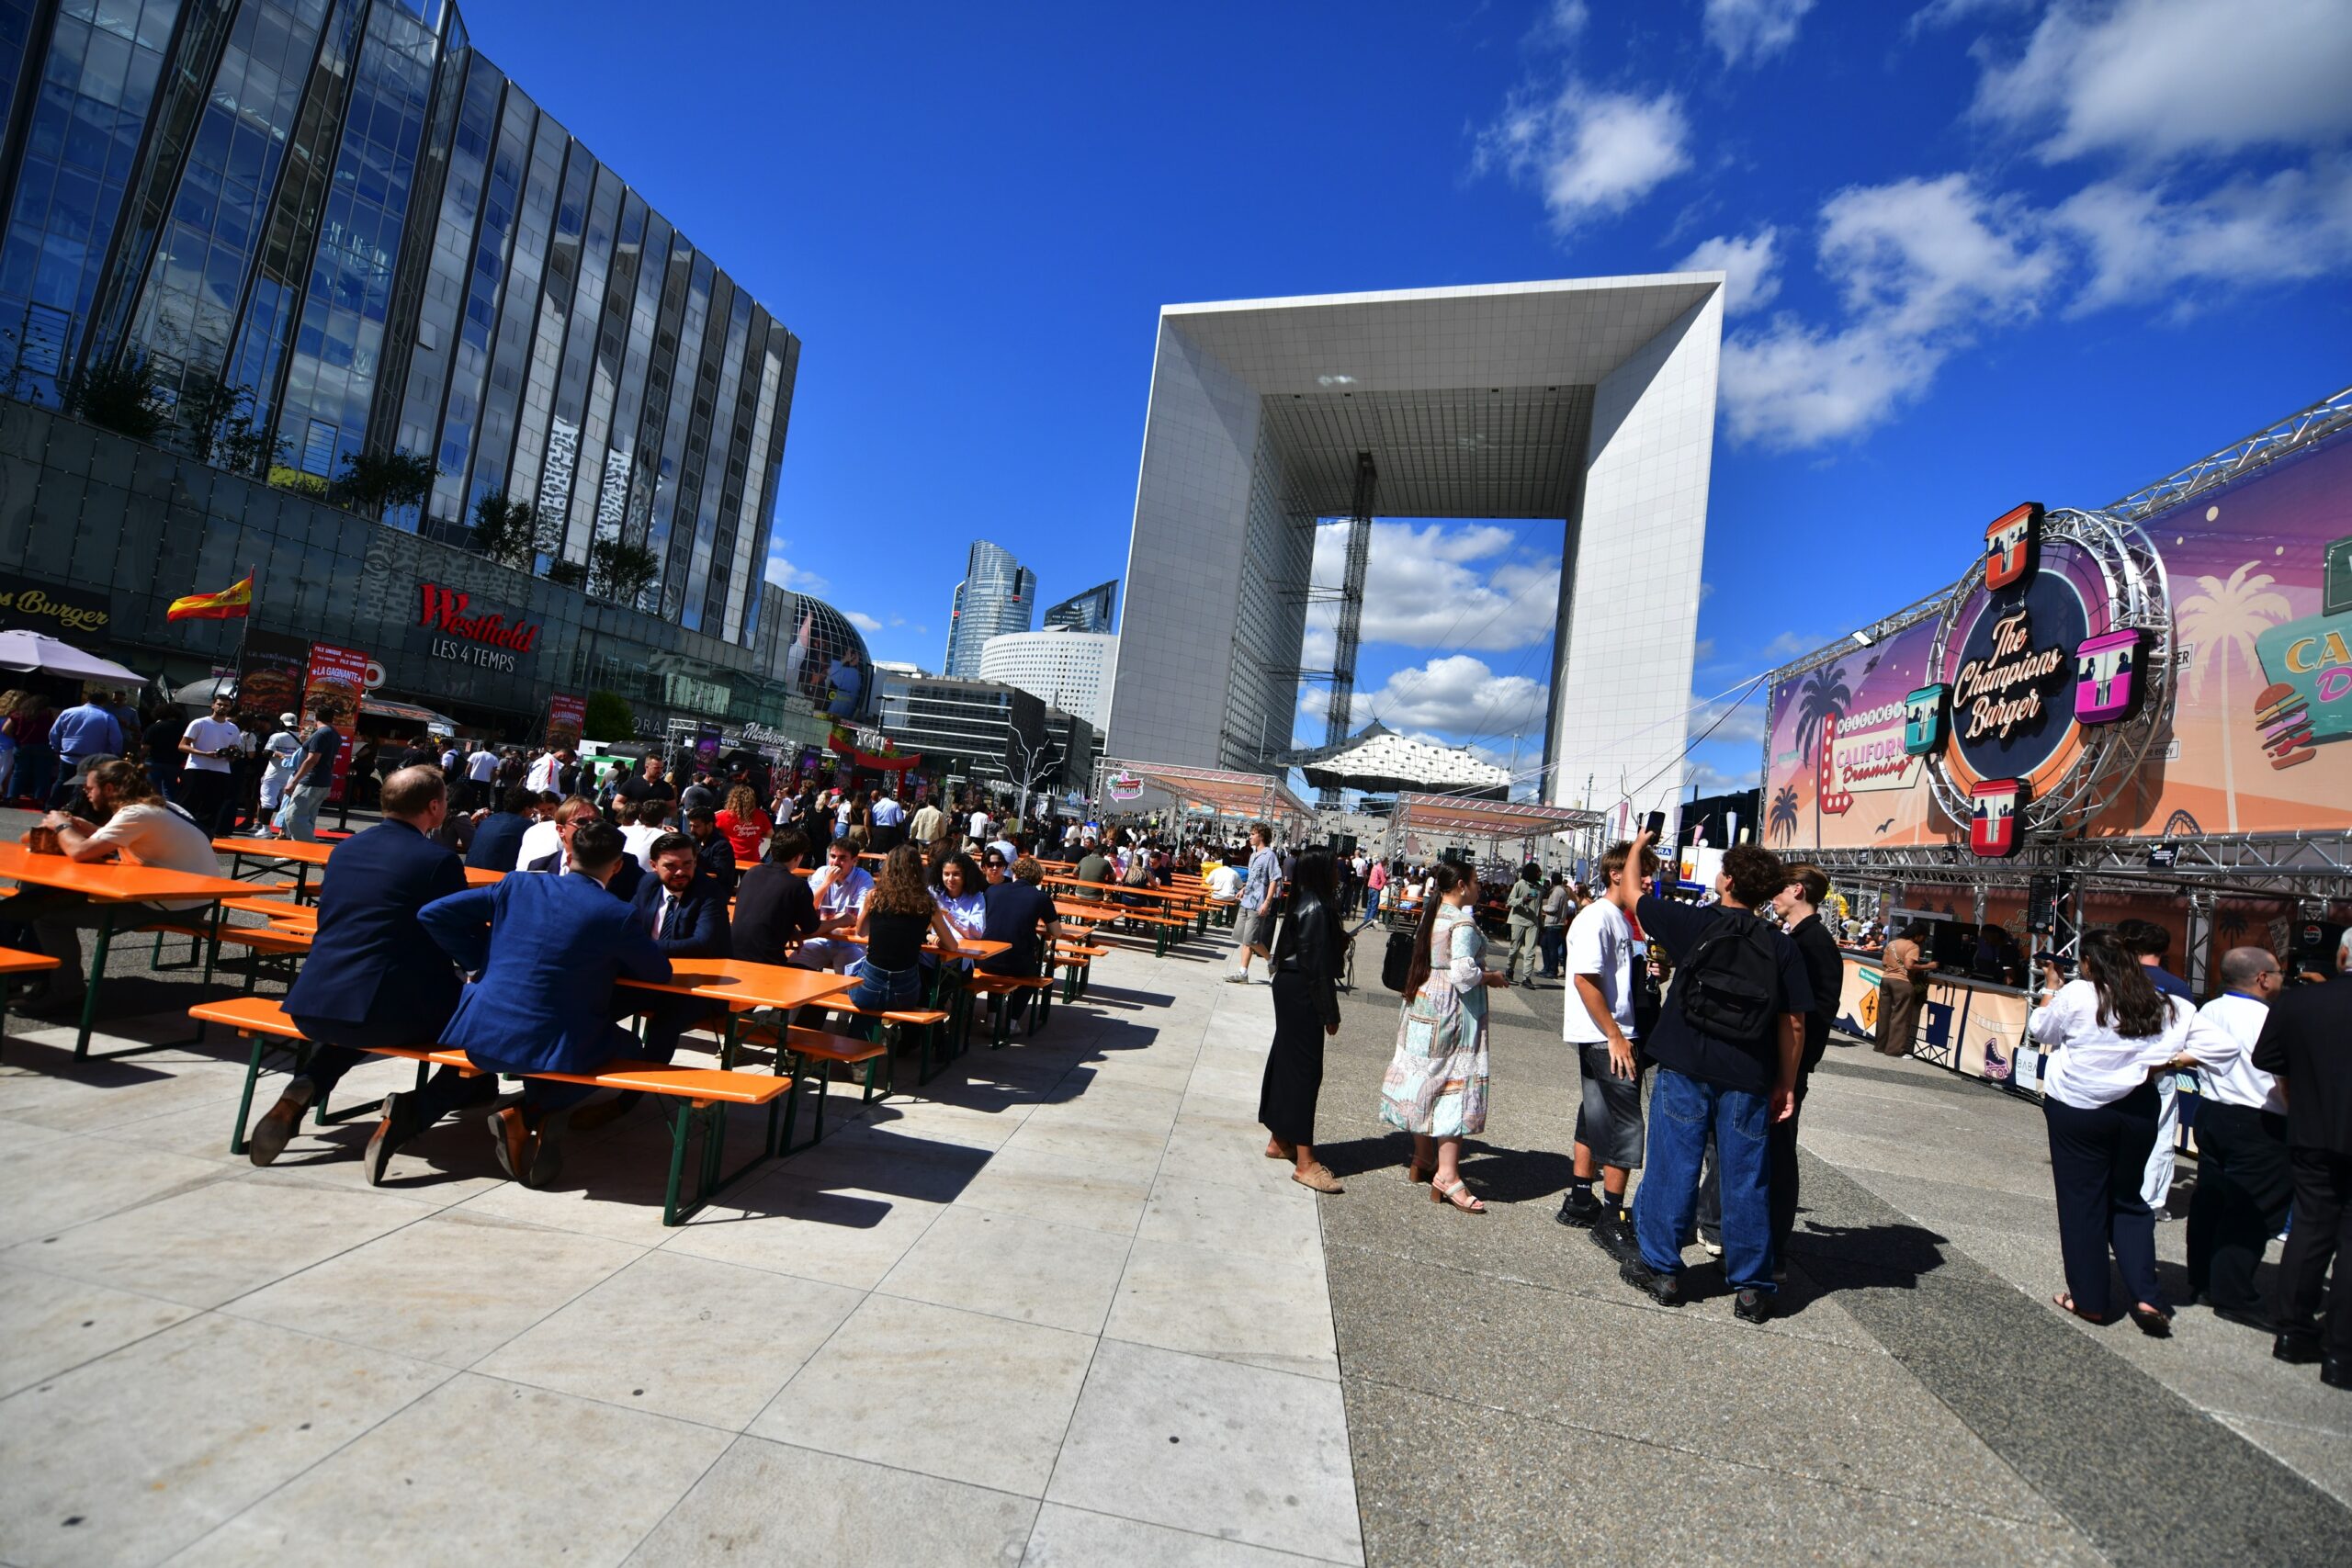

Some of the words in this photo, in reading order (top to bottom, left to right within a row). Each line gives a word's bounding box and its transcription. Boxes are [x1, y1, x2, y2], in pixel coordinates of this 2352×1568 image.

[17, 591, 108, 632] Burger
[418, 583, 539, 653] Westfield
[432, 637, 458, 660] LES
[460, 645, 469, 662] 4
[473, 647, 514, 672] TEMPS
[1987, 610, 2028, 669] The
[317, 666, 325, 676] LA
[326, 667, 358, 682] GAGNANTE
[1953, 649, 2063, 708] Champions
[1838, 706, 1892, 732] WELCOME
[1965, 688, 2041, 739] Burger
[742, 722, 789, 746] Madison
[1838, 736, 1907, 768] CALIFORN
[1843, 757, 1908, 784] Dreaming
